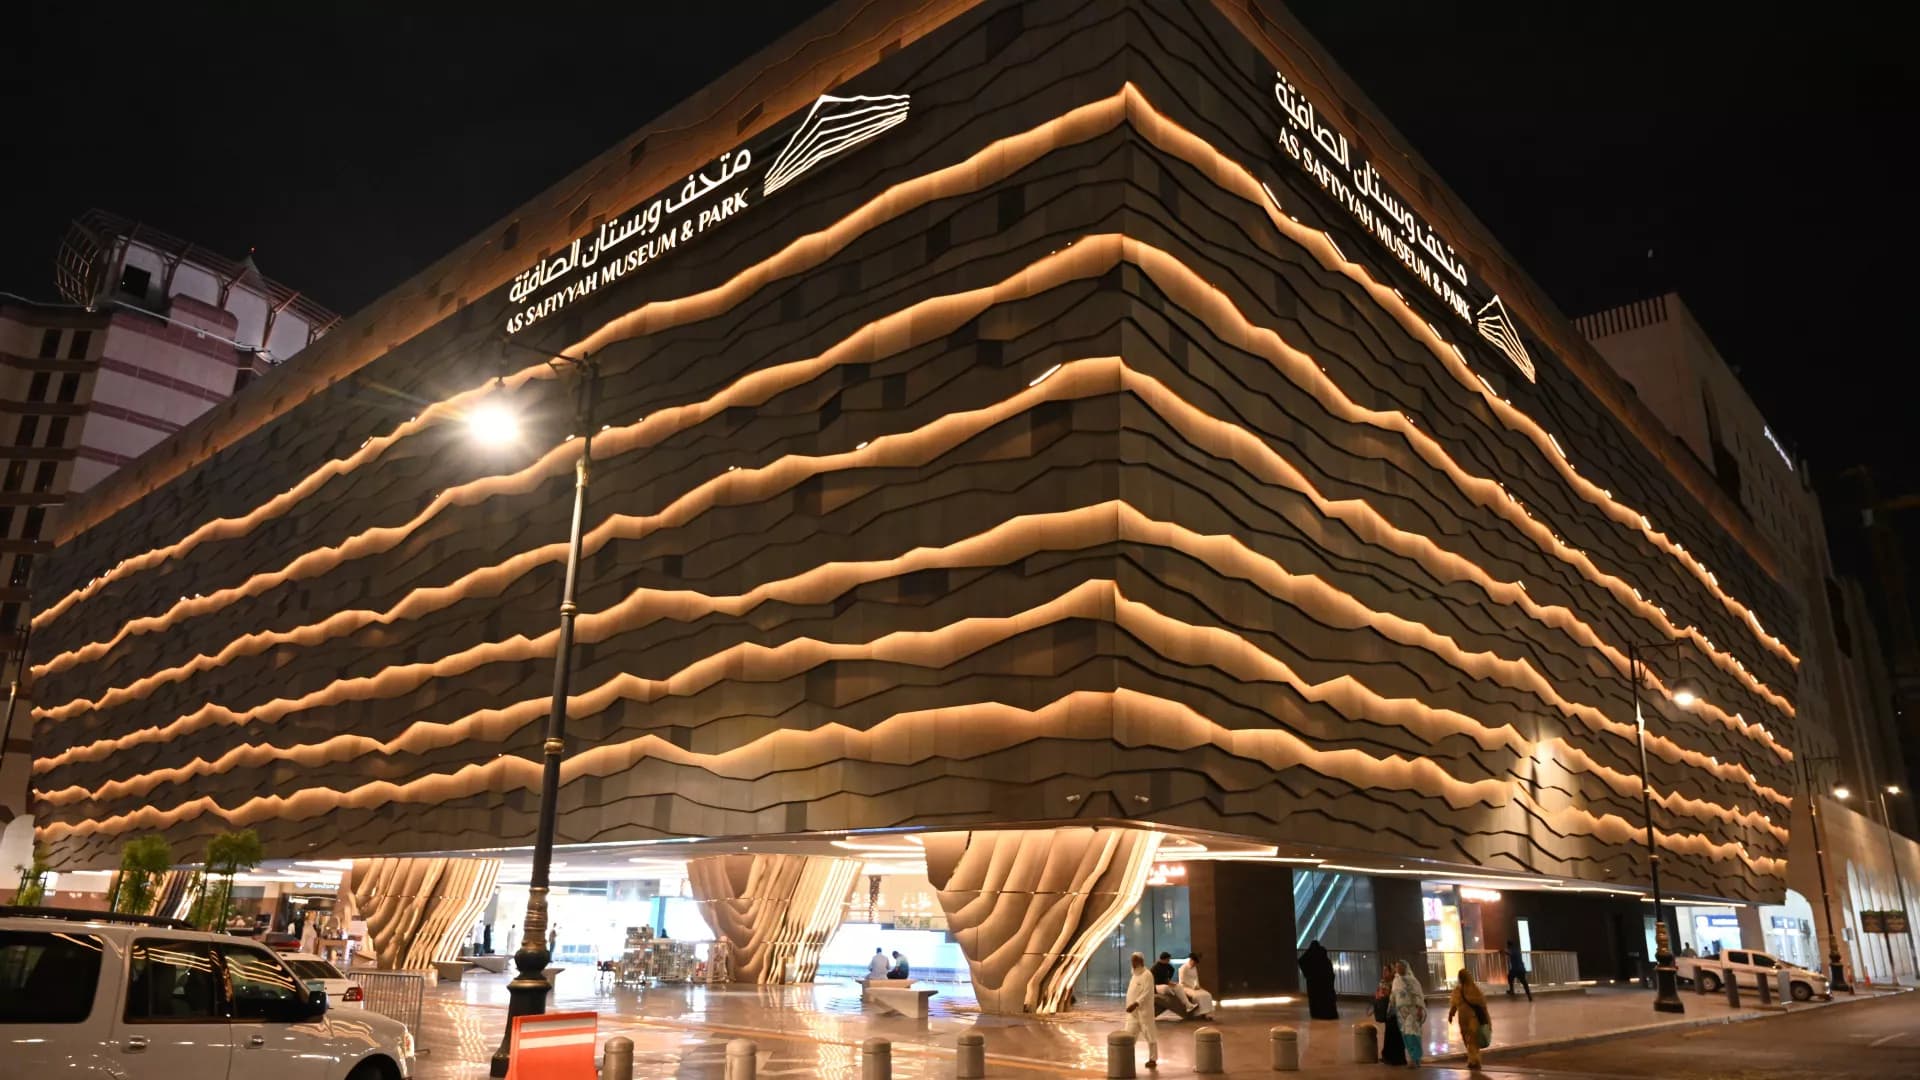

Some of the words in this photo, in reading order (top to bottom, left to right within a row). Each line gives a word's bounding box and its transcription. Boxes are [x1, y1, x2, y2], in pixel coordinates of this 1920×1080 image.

[666, 149, 751, 213] متحف
[1354, 160, 1415, 244] وبستان
[506, 312, 524, 334] AS
[525, 271, 598, 326] SAFIYYAH
[601, 227, 677, 285] MUSEUM
[680, 219, 694, 242] &
[698, 187, 749, 232] PARK
[582, 200, 661, 268] وبستان
[1278, 126, 1300, 160] AS
[1303, 147, 1374, 232] SAFIYYAH
[1376, 217, 1431, 287] MUSEUM
[1433, 272, 1442, 297] &
[1443, 281, 1472, 325] PARK
[1416, 224, 1468, 286] متحف
